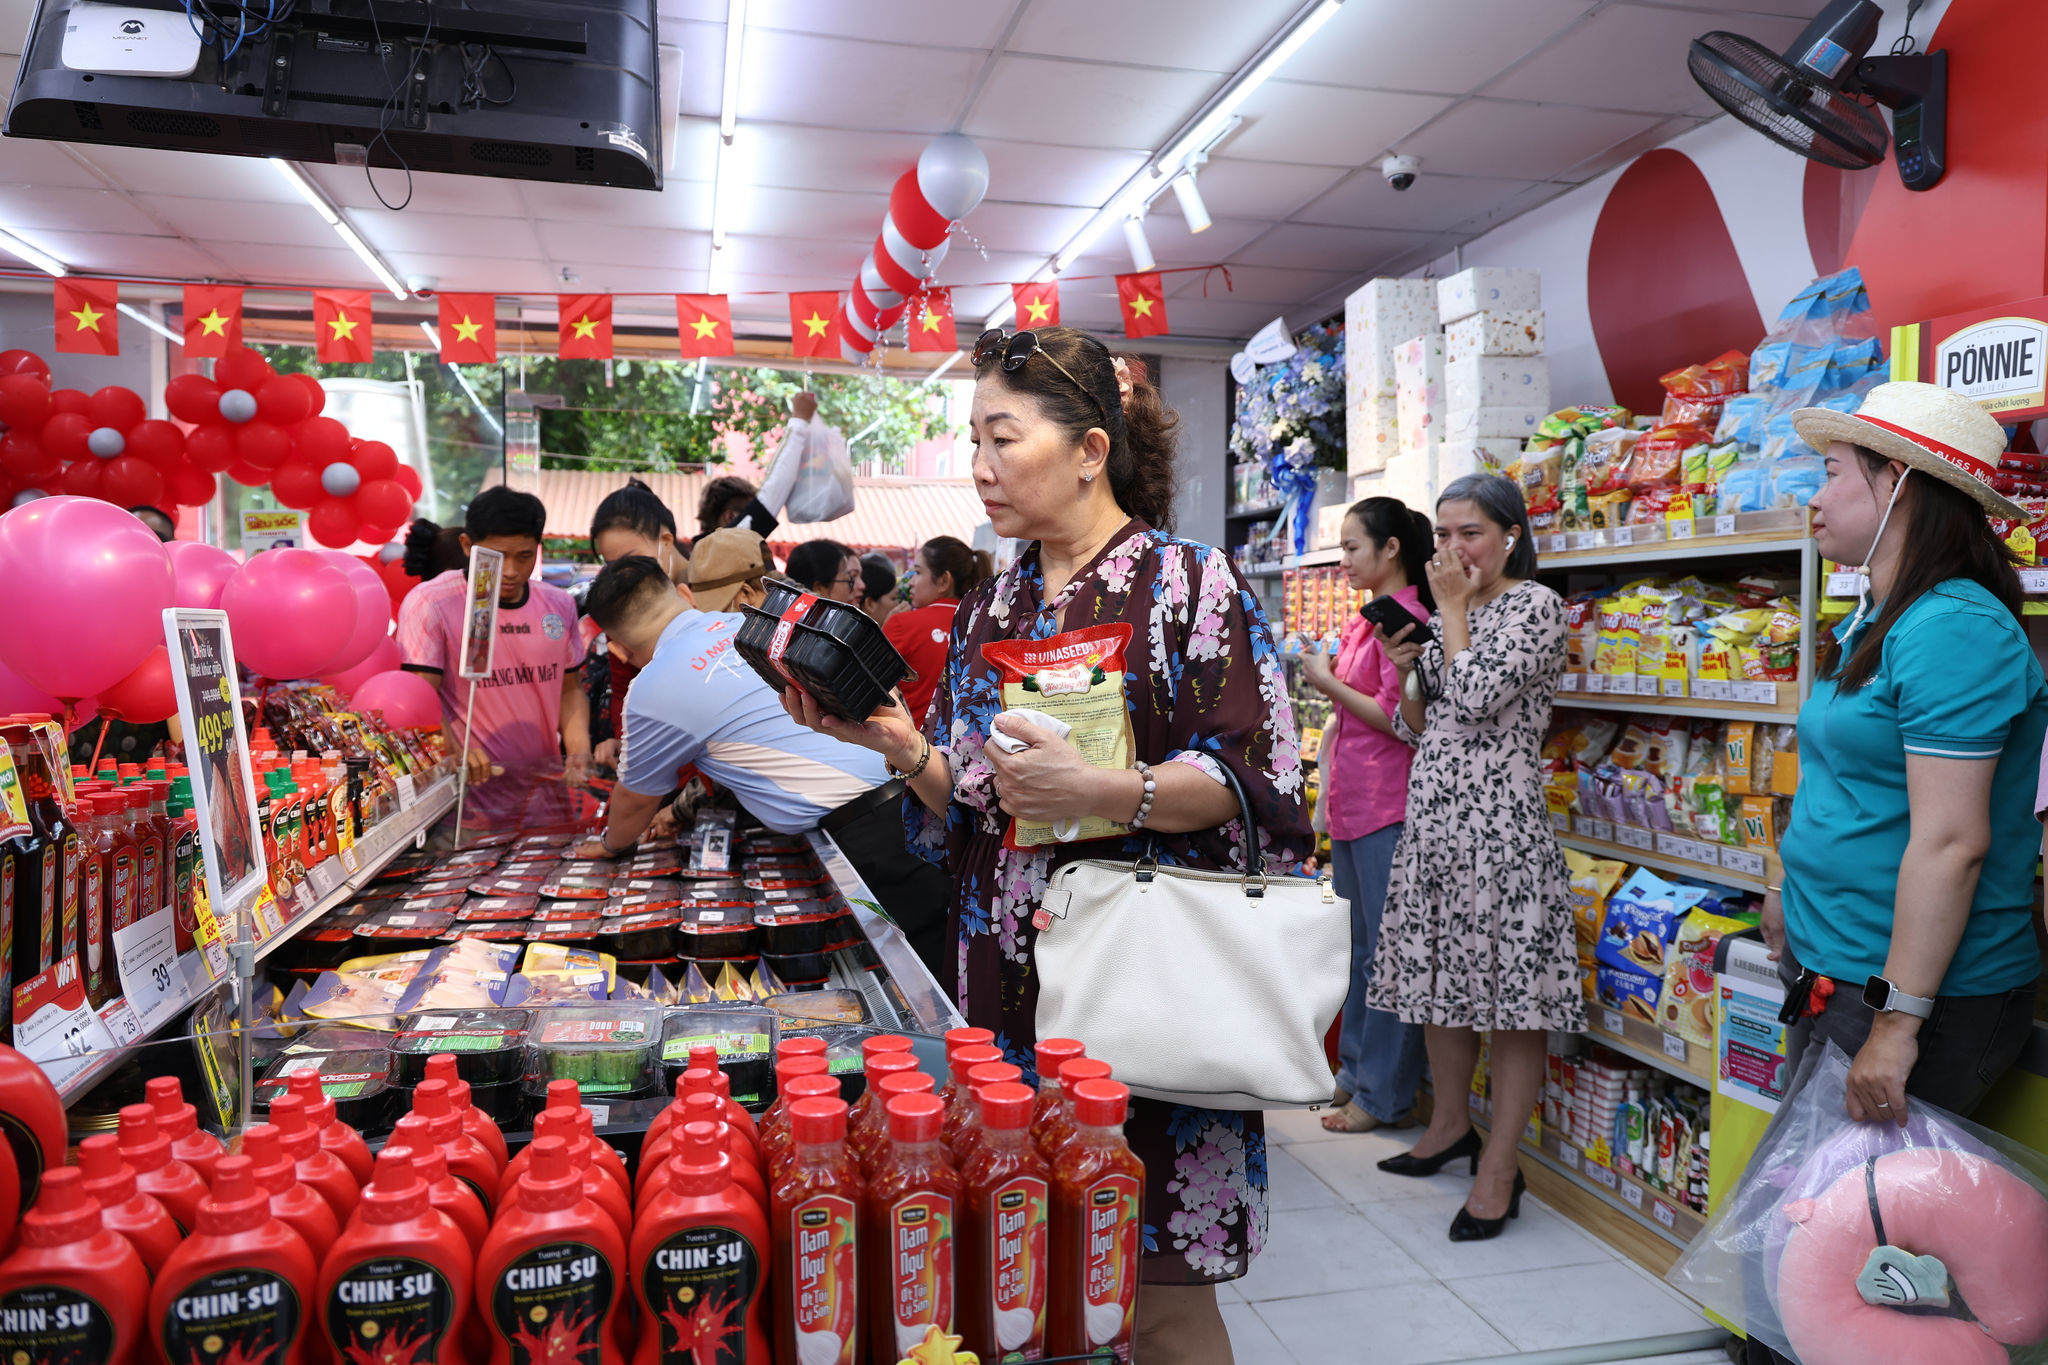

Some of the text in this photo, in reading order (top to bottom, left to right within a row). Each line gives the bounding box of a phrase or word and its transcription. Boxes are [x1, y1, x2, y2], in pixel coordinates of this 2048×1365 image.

[1946, 336, 2036, 388] PÖNNIE
[1994, 398, 2009, 409] chất
[515, 662, 535, 684] MÁY
[1727, 737, 1745, 766] Vị
[1743, 815, 1767, 844] Vị
[152, 963, 171, 992] 39
[122, 1018, 136, 1036] 25
[998, 1210, 1025, 1237] Nam
[1091, 1207, 1118, 1234] Nam
[800, 1229, 830, 1255] Nam
[899, 1226, 928, 1252] Nam
[655, 1241, 743, 1270] CHIN-SU
[337, 1271, 433, 1304] CHIN-SU
[505, 1255, 598, 1291] CHIN-SU
[176, 1281, 280, 1321] CHIN-SU
